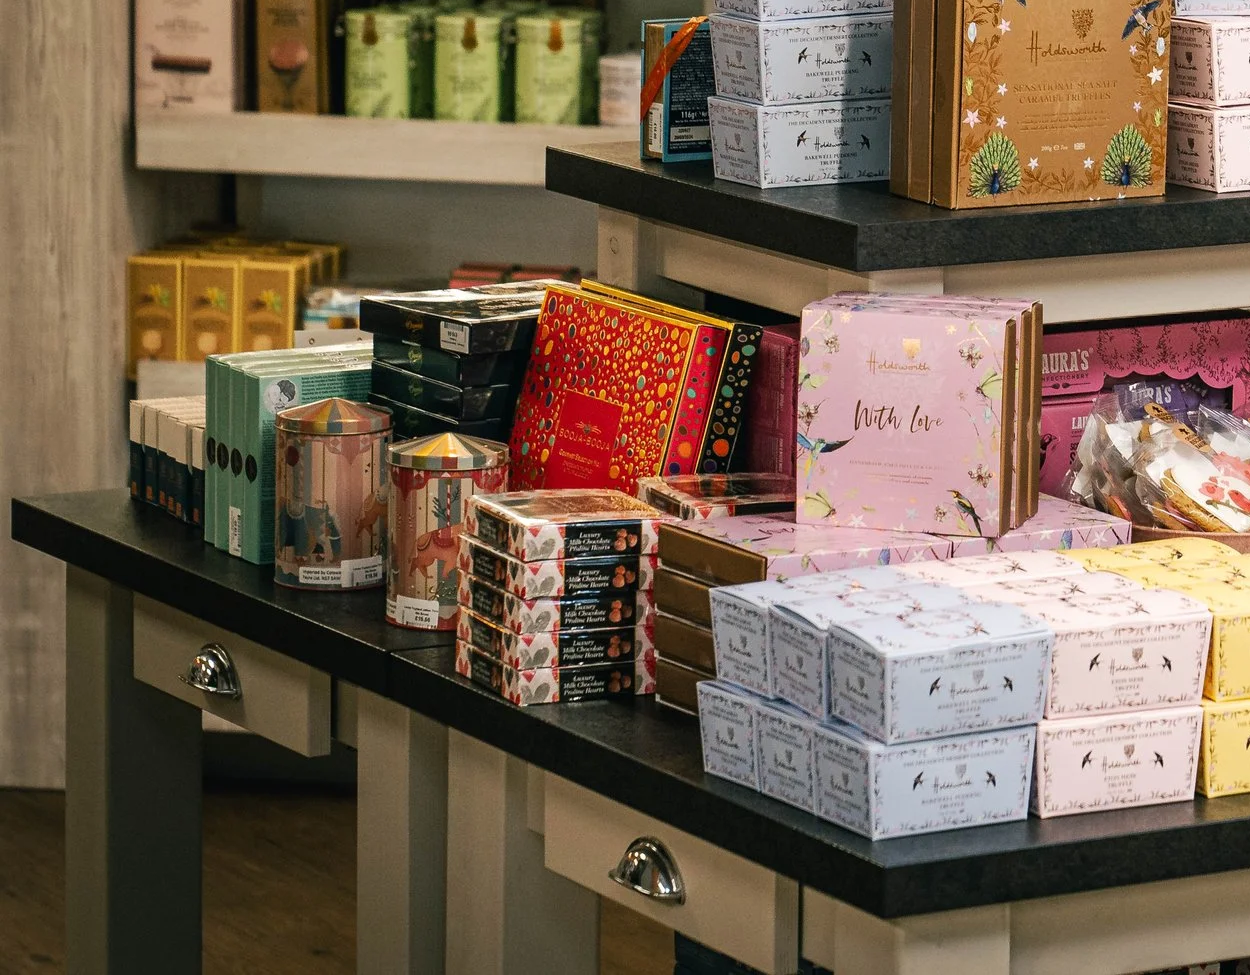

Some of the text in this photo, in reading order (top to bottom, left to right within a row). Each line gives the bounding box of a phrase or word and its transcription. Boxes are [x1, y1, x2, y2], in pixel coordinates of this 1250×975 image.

[1026, 30, 1107, 66] Holdsworth
[815, 52, 851, 70] Holdsworth
[1013, 84, 1073, 93] SENSATIONAL
[1095, 80, 1118, 88] SALT
[1020, 92, 1112, 104] CARAMEL TRUFFLES
[814, 136, 850, 152] Holdsworth
[866, 351, 930, 375] Holdsworth
[1042, 350, 1090, 374] AURA'S
[1042, 372, 1090, 382] NFECTIONERY
[855, 399, 944, 434] With Love
[558, 428, 610, 451] BOOJA-BOOJA
